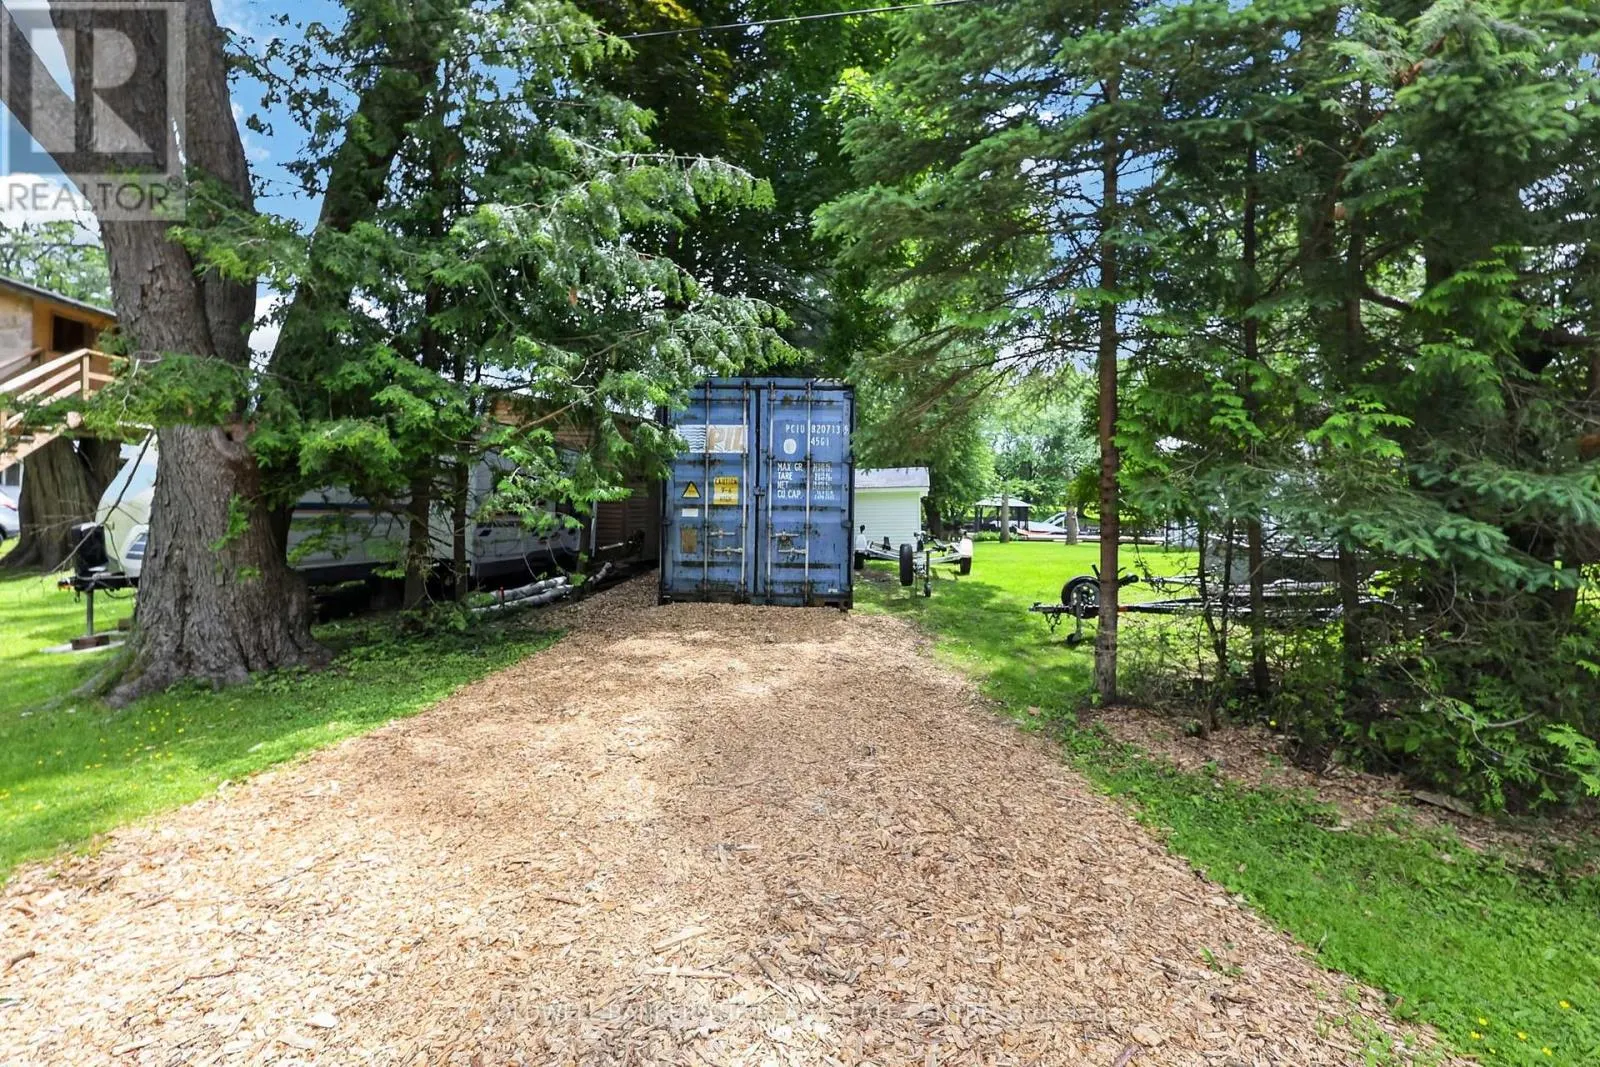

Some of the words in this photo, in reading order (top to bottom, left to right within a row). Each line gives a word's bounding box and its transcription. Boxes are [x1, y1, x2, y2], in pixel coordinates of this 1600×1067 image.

[785, 424, 805, 434] PCIU
[811, 424, 841, 434] 820713
[810, 436, 830, 446] 45G1
[777, 462, 791, 471] MAX
[778, 471, 792, 480] TARE
[777, 480, 789, 489] NET
